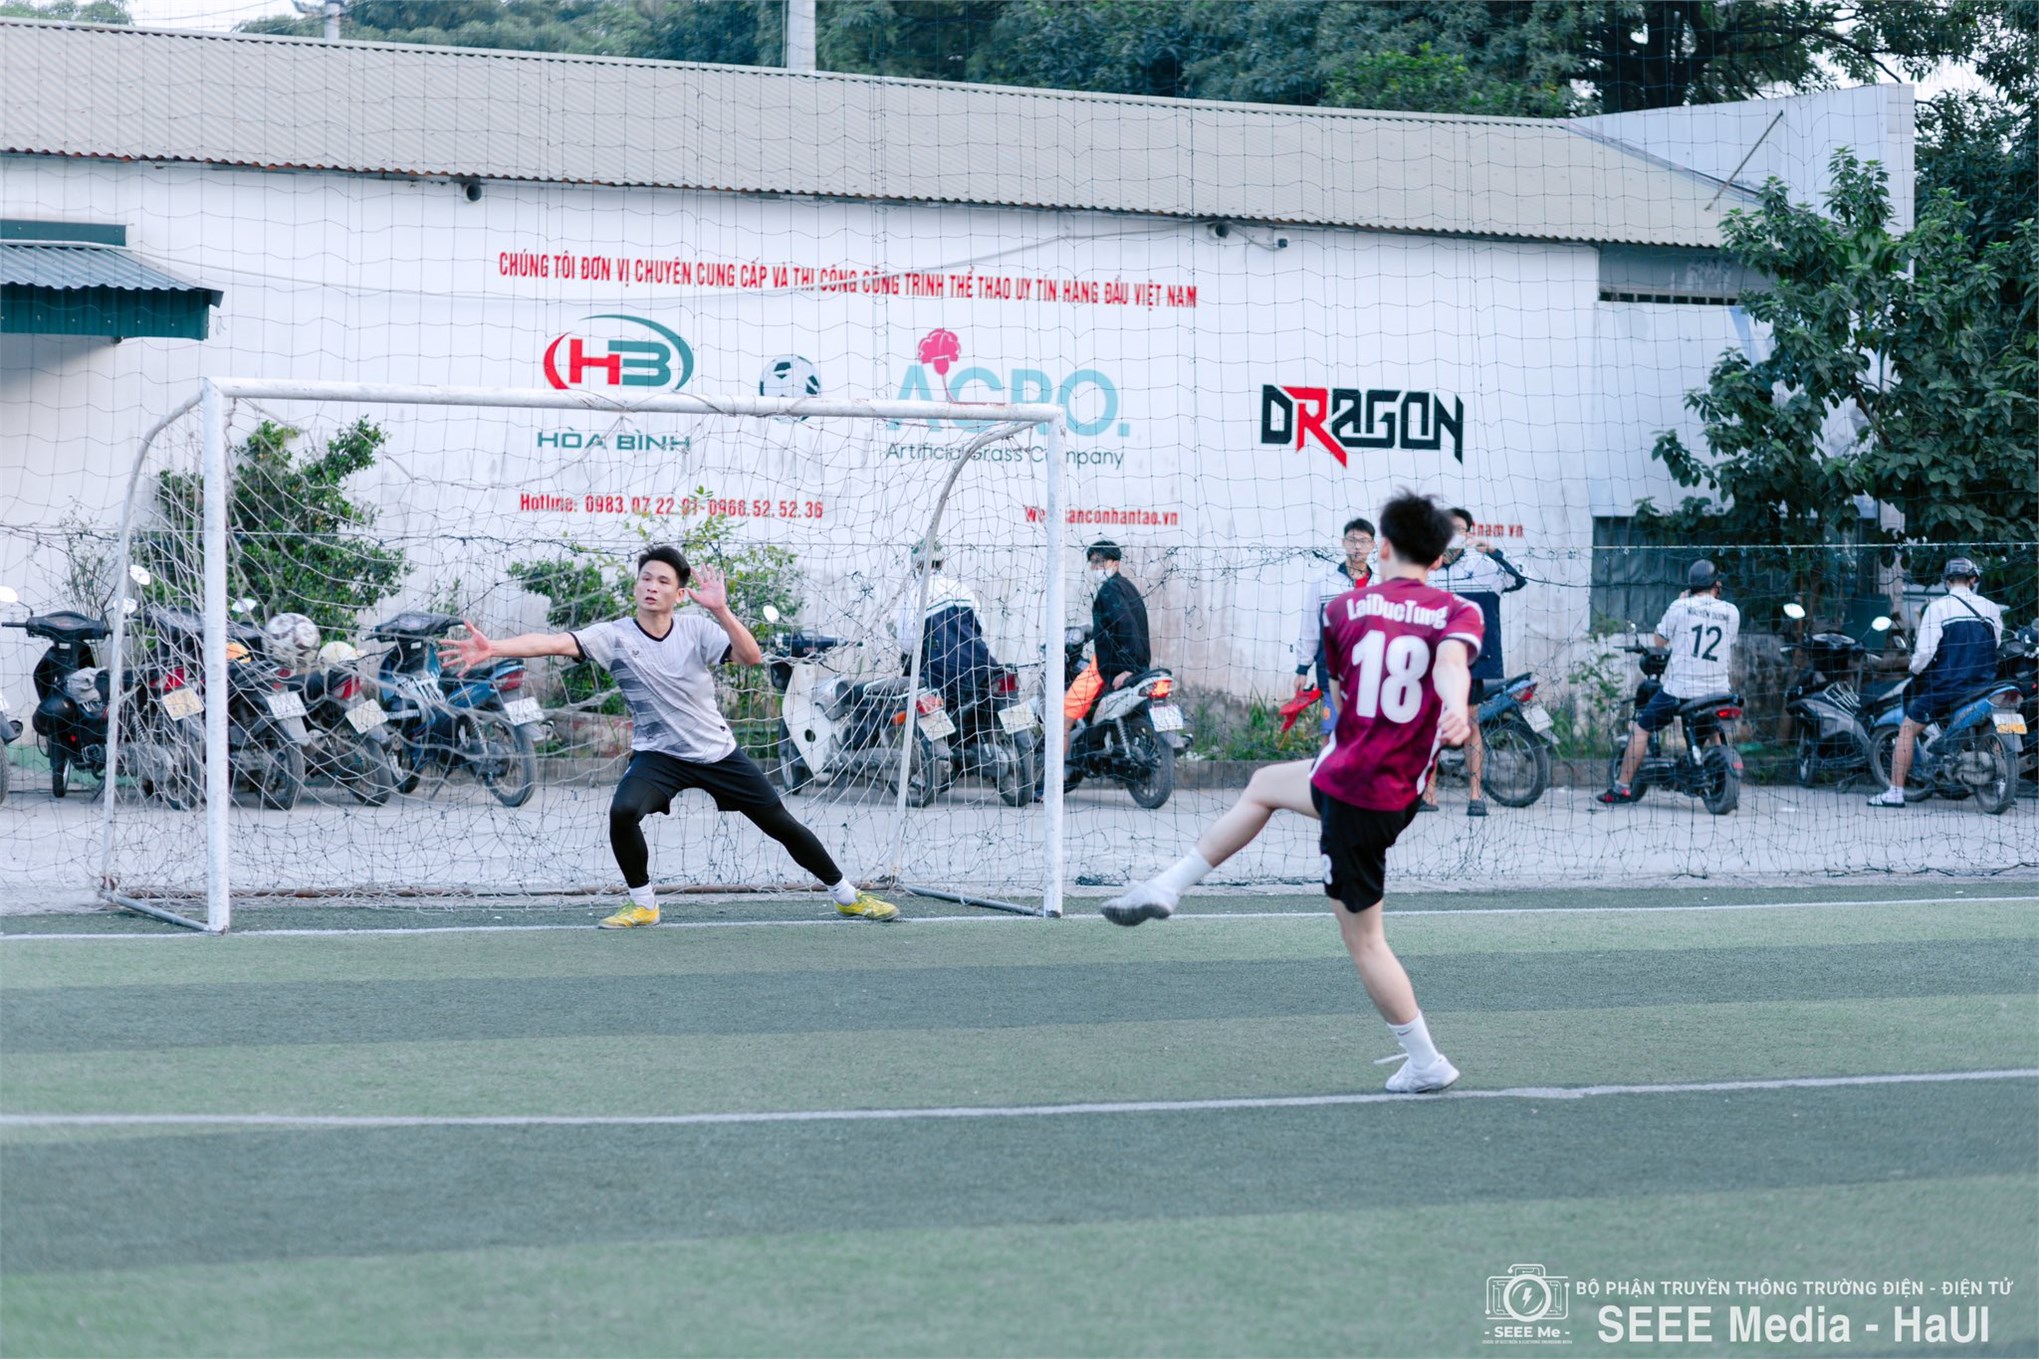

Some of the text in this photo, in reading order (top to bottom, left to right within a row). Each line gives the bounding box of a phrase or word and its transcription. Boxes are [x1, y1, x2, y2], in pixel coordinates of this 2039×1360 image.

[499, 247, 549, 279] CHÚNG
[553, 249, 576, 279] TÔI
[580, 254, 611, 281] ĐƠN
[616, 257, 630, 287] VỊ
[635, 256, 692, 286] CHUYÊN
[696, 262, 735, 287] CUNG
[740, 256, 768, 288] CẤP
[793, 267, 815, 291] THI
[820, 264, 858, 293] CÔNG
[862, 266, 900, 295] CÔNG
[977, 275, 1011, 300] THAO
[1016, 278, 1033, 301] UY
[1037, 274, 1057, 302] TÍN
[1134, 279, 1162, 312] VIỆT
[1167, 284, 1197, 308] NAM
[537, 426, 690, 452] HÒA BÌNH
[1261, 384, 1464, 469] DRAGON
[1031, 445, 1124, 470] Cmpany
[520, 493, 578, 513] Hotline:
[1065, 508, 1179, 526] anconhantao.vn
[1346, 593, 1449, 630] LaiDucTung
[1690, 623, 1723, 663] 12
[1351, 629, 1431, 724] 18
